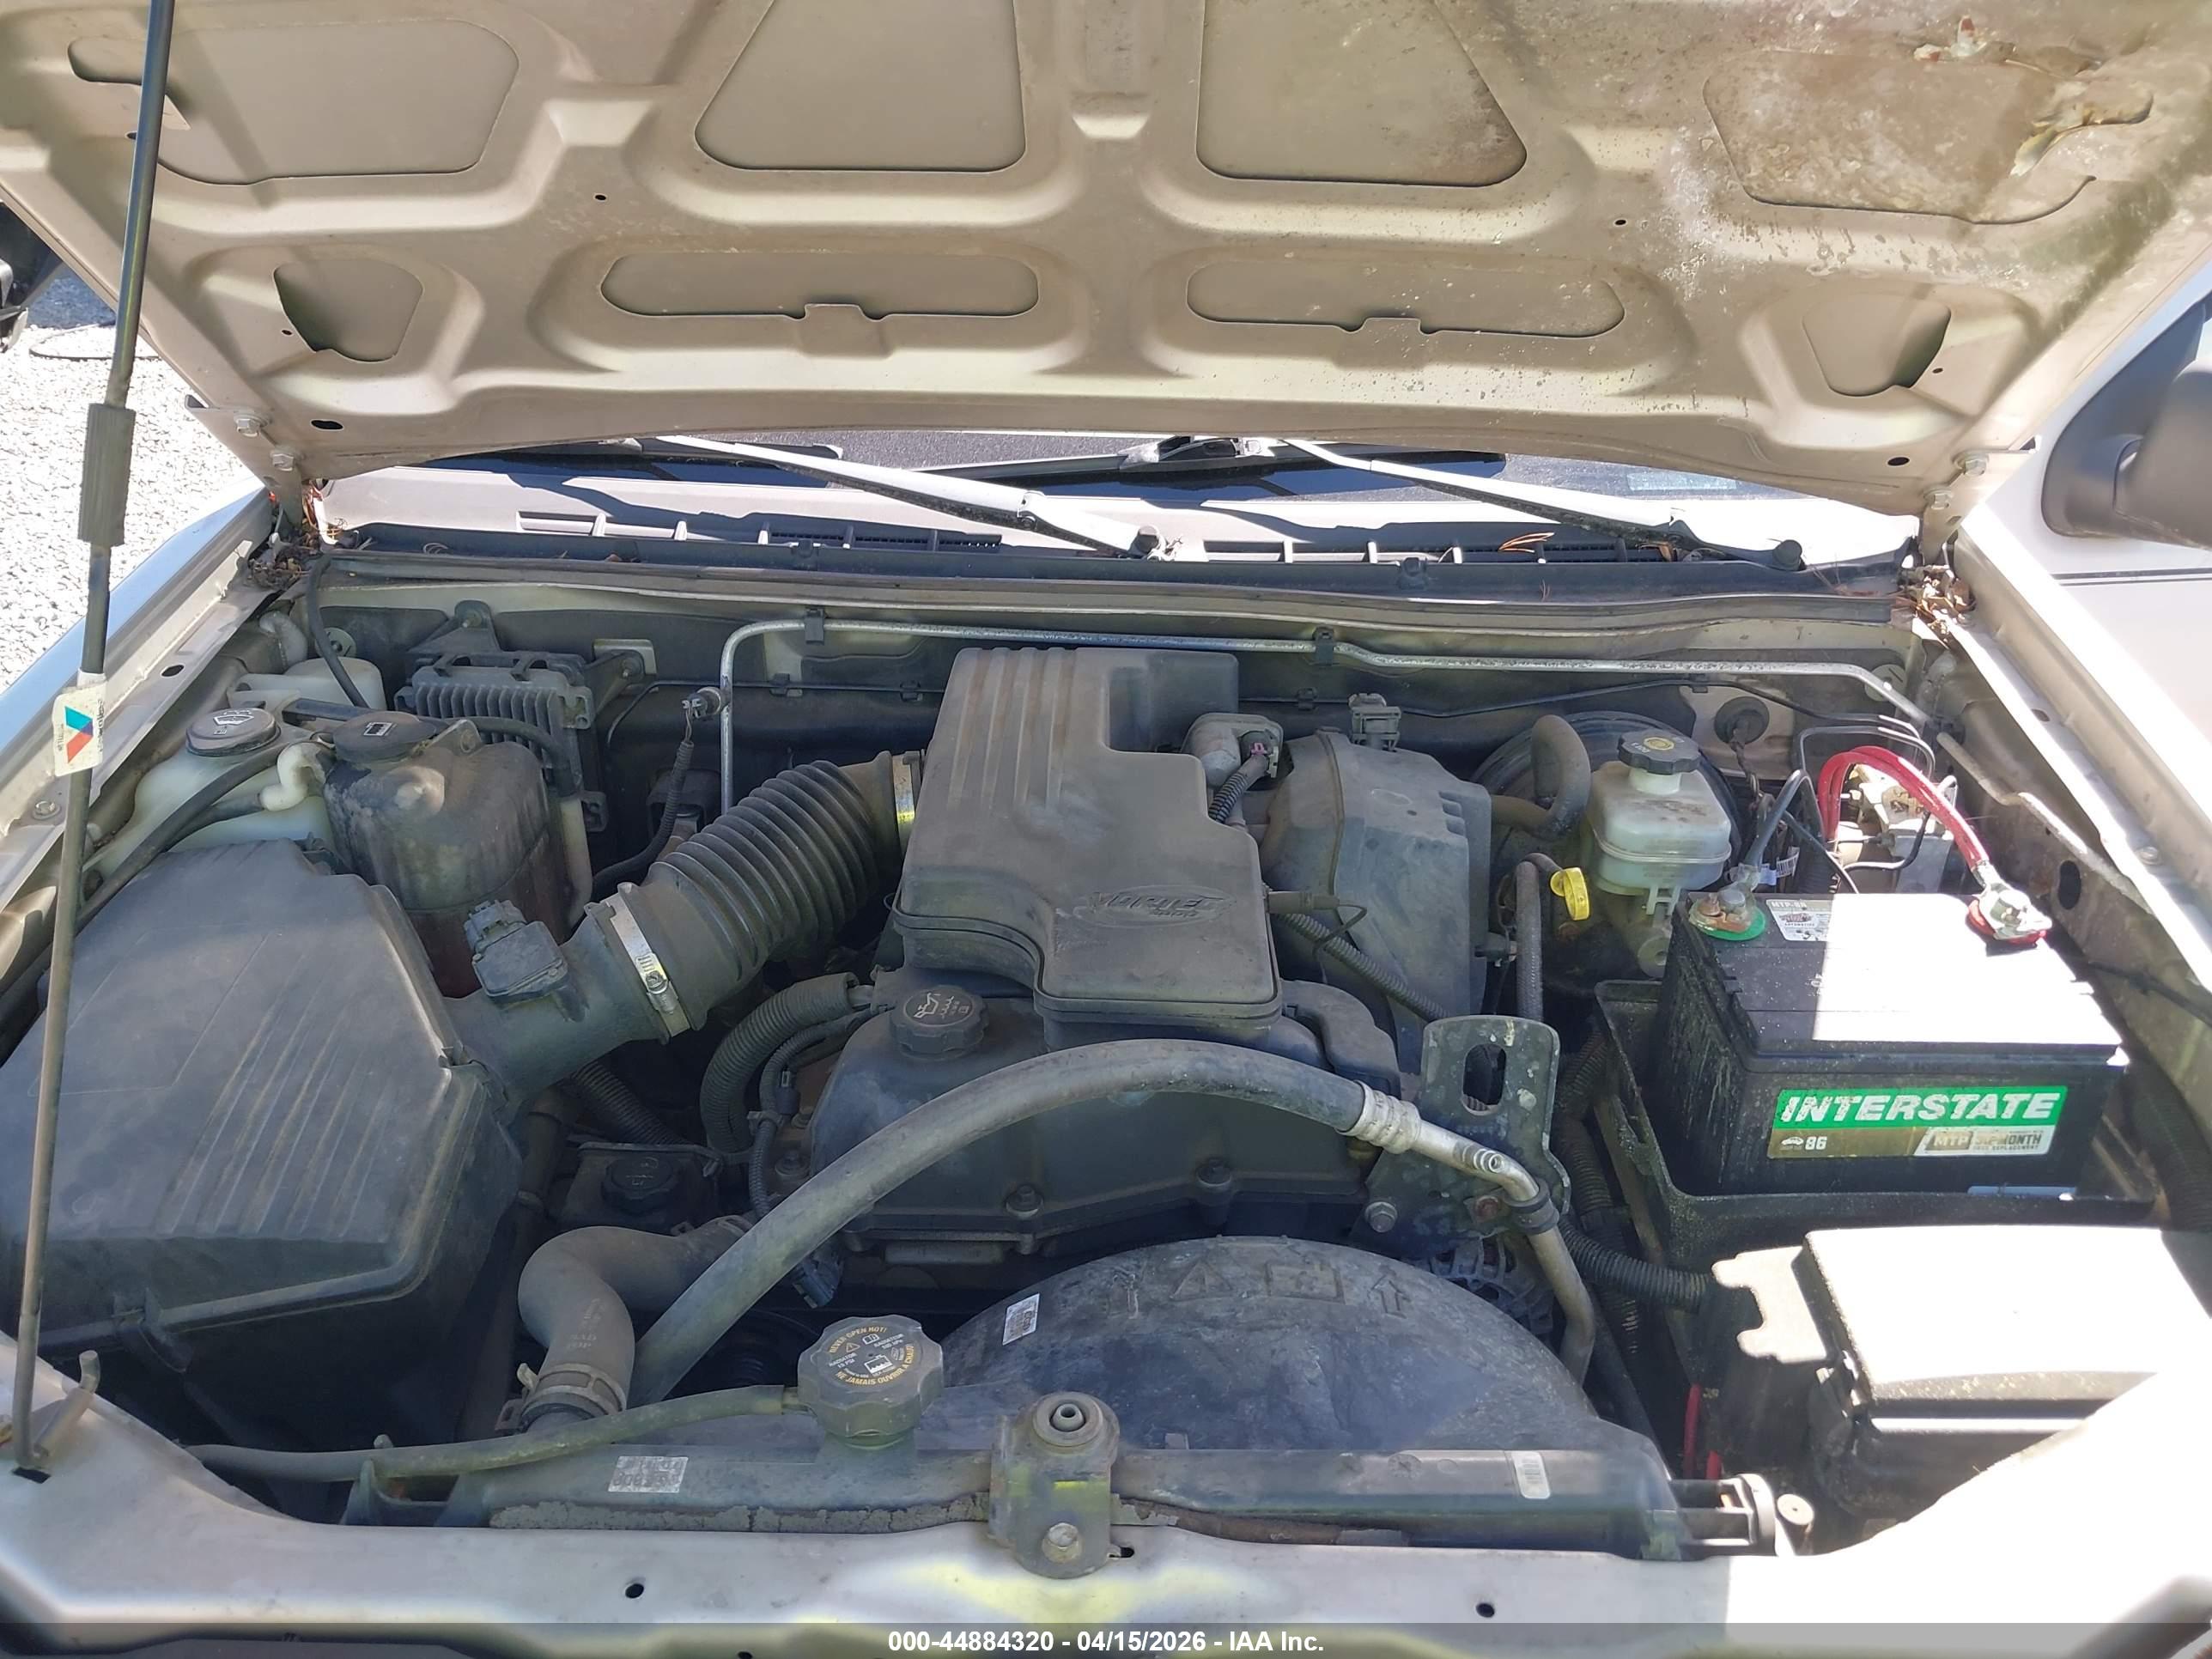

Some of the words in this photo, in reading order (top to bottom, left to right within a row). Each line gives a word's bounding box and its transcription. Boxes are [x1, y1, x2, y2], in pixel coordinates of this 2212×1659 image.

[1781, 1092, 2060, 1122] INTERSTATE
[1805, 1136, 1828, 1151] 86
[1933, 1134, 1969, 1147] MTP
[846, 1328, 867, 1339] OPEN
[845, 1376, 877, 1386] JAMAIS
